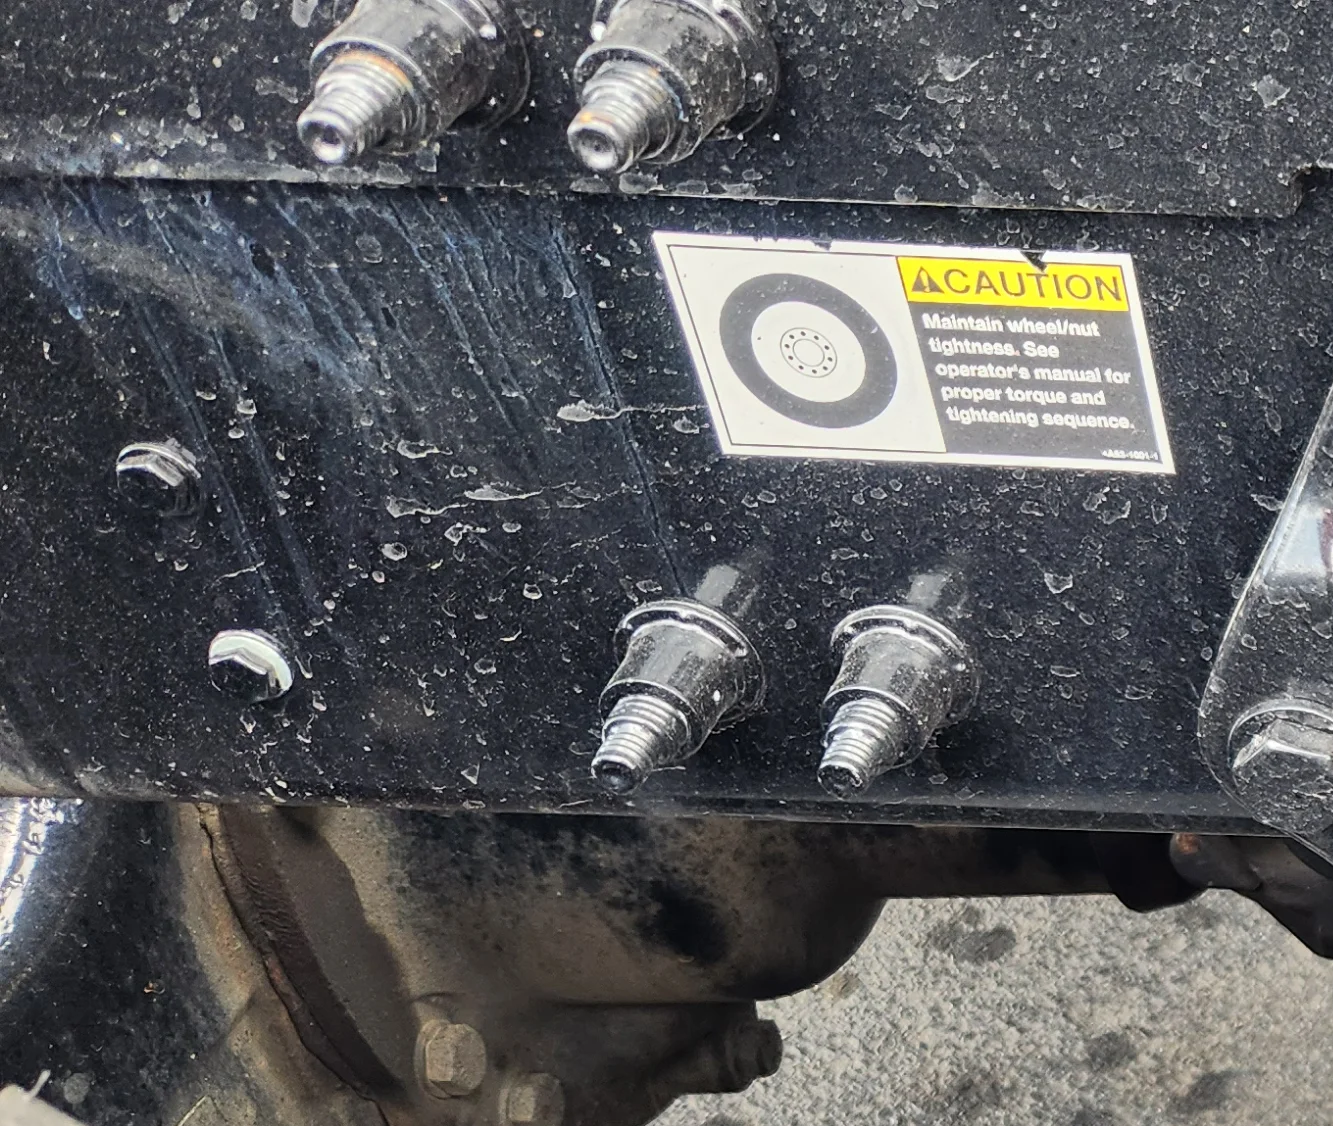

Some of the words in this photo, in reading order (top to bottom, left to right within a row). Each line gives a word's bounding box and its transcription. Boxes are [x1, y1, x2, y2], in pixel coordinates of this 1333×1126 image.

[943, 269, 1122, 302] CAUTION
[922, 313, 1004, 333] Maintain
[1007, 317, 1101, 337] wheel/nut
[928, 338, 1020, 358] tightness.
[1023, 341, 1060, 358] See
[935, 362, 1030, 381] operator's
[1034, 366, 1102, 382] manual
[1104, 368, 1131, 384] for
[941, 386, 1002, 402] proper
[1005, 387, 1067, 406] torque
[1071, 390, 1106, 406] and
[946, 406, 1039, 428] tightening
[1042, 411, 1135, 430] sequence.
